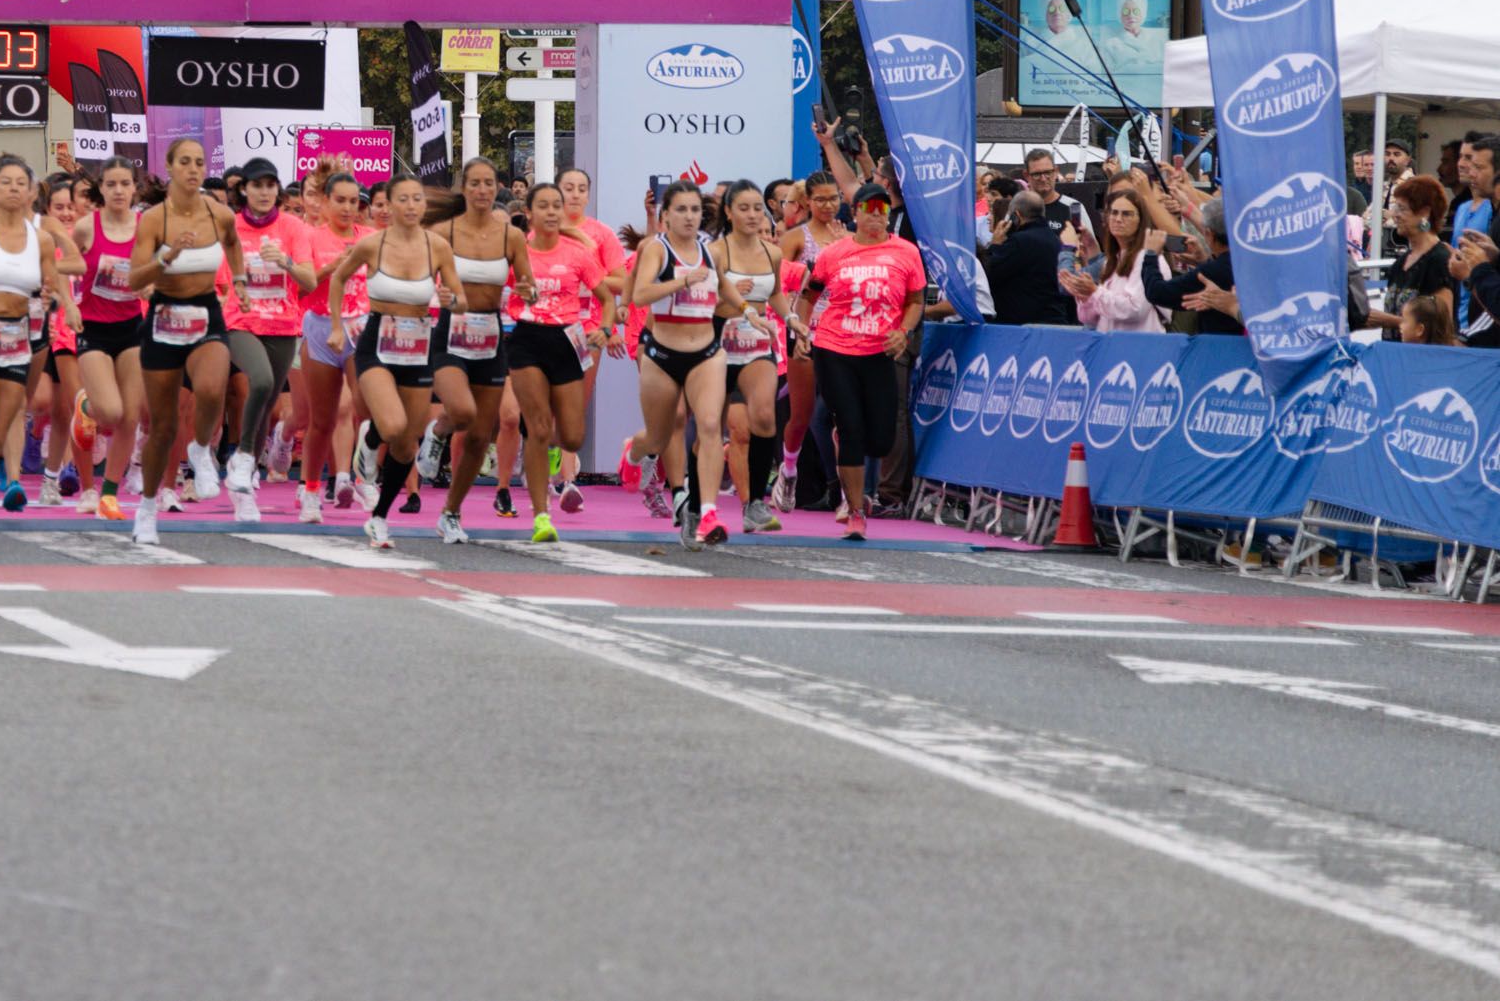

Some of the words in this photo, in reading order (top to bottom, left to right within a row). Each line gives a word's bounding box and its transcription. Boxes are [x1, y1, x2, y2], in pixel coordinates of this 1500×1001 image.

[448, 36, 494, 49] CORRER
[177, 60, 300, 89] OYSHO
[654, 59, 736, 78] ASTURIANA
[645, 113, 745, 135] OYSHO
[352, 136, 389, 146] OYSHO
[1189, 398, 1266, 437] ASTURIANA
